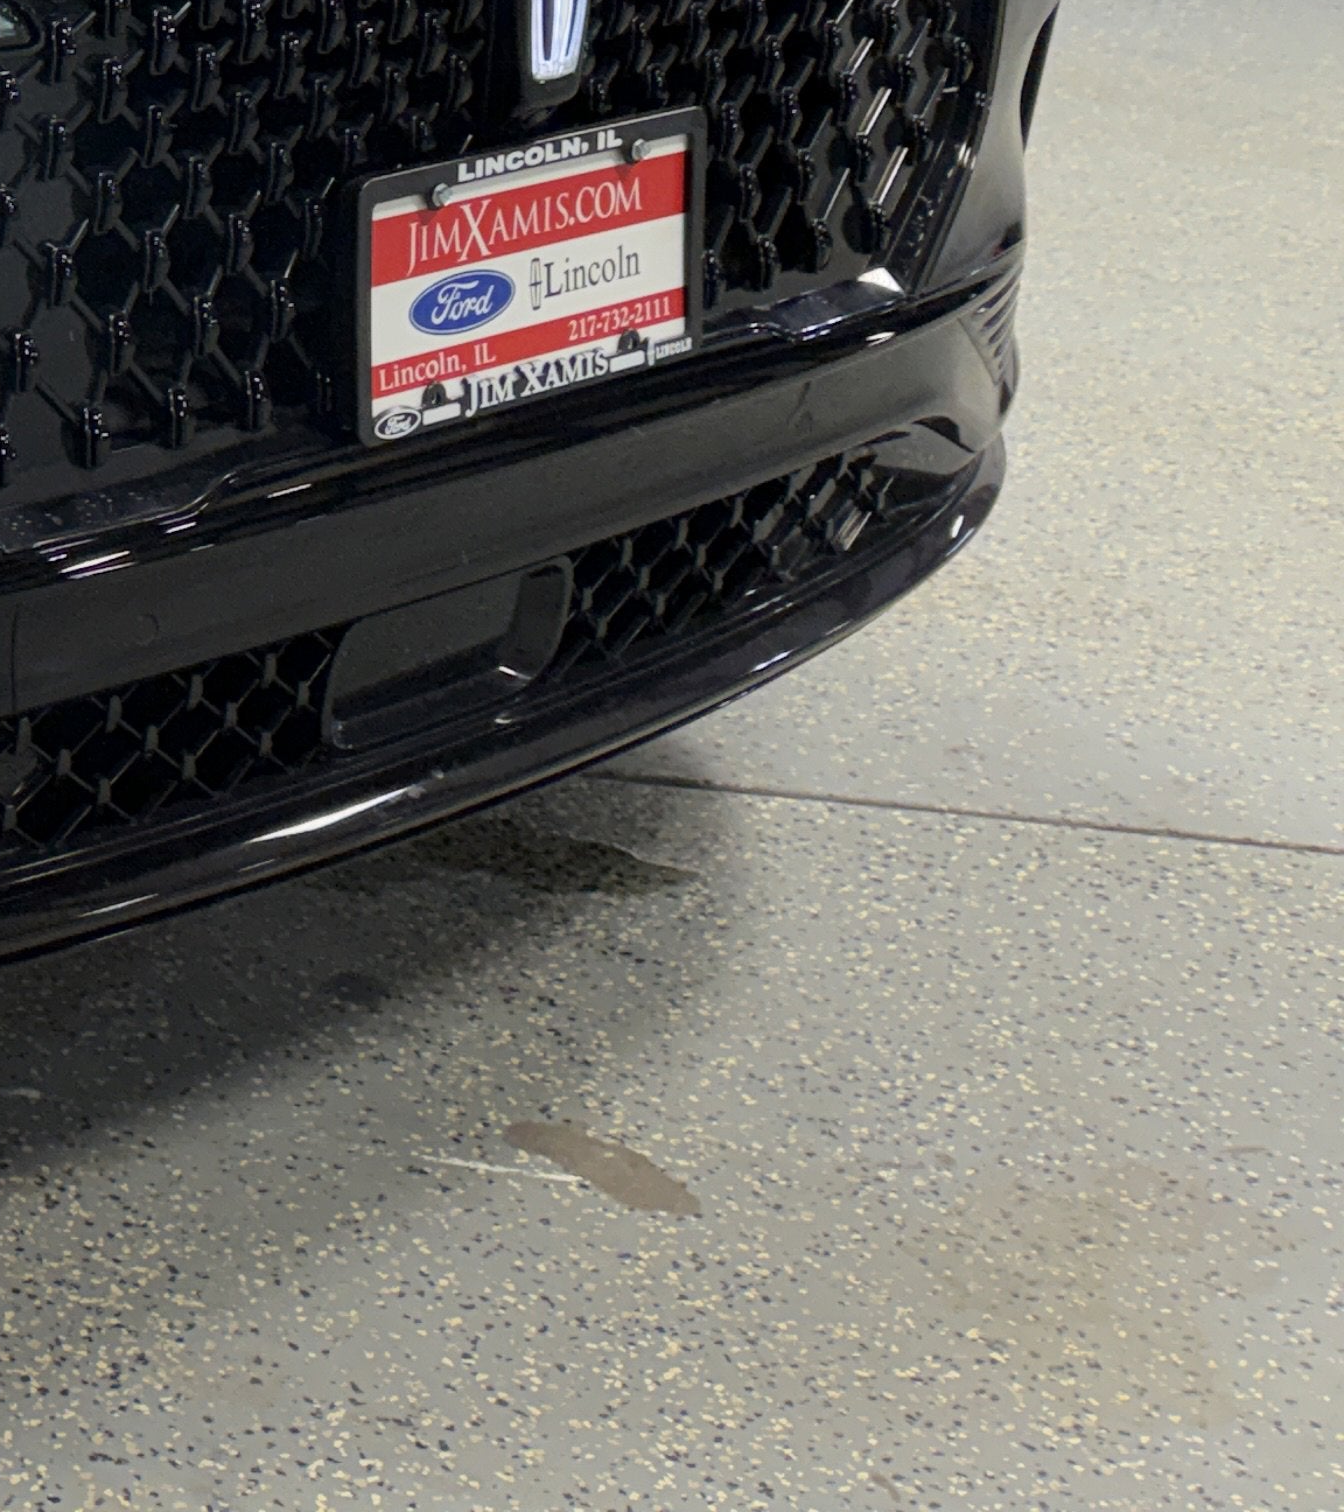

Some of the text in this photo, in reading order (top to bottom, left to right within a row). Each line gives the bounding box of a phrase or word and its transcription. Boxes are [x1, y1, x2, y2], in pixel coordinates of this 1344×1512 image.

[458, 129, 624, 183] LINCOLN, IL
[544, 244, 641, 298] Lincoln
[431, 280, 495, 326] Ford
[568, 296, 671, 342] 217-732-2111
[379, 342, 497, 392] Lincoln, IL
[464, 349, 609, 418] JIM XAMIS
